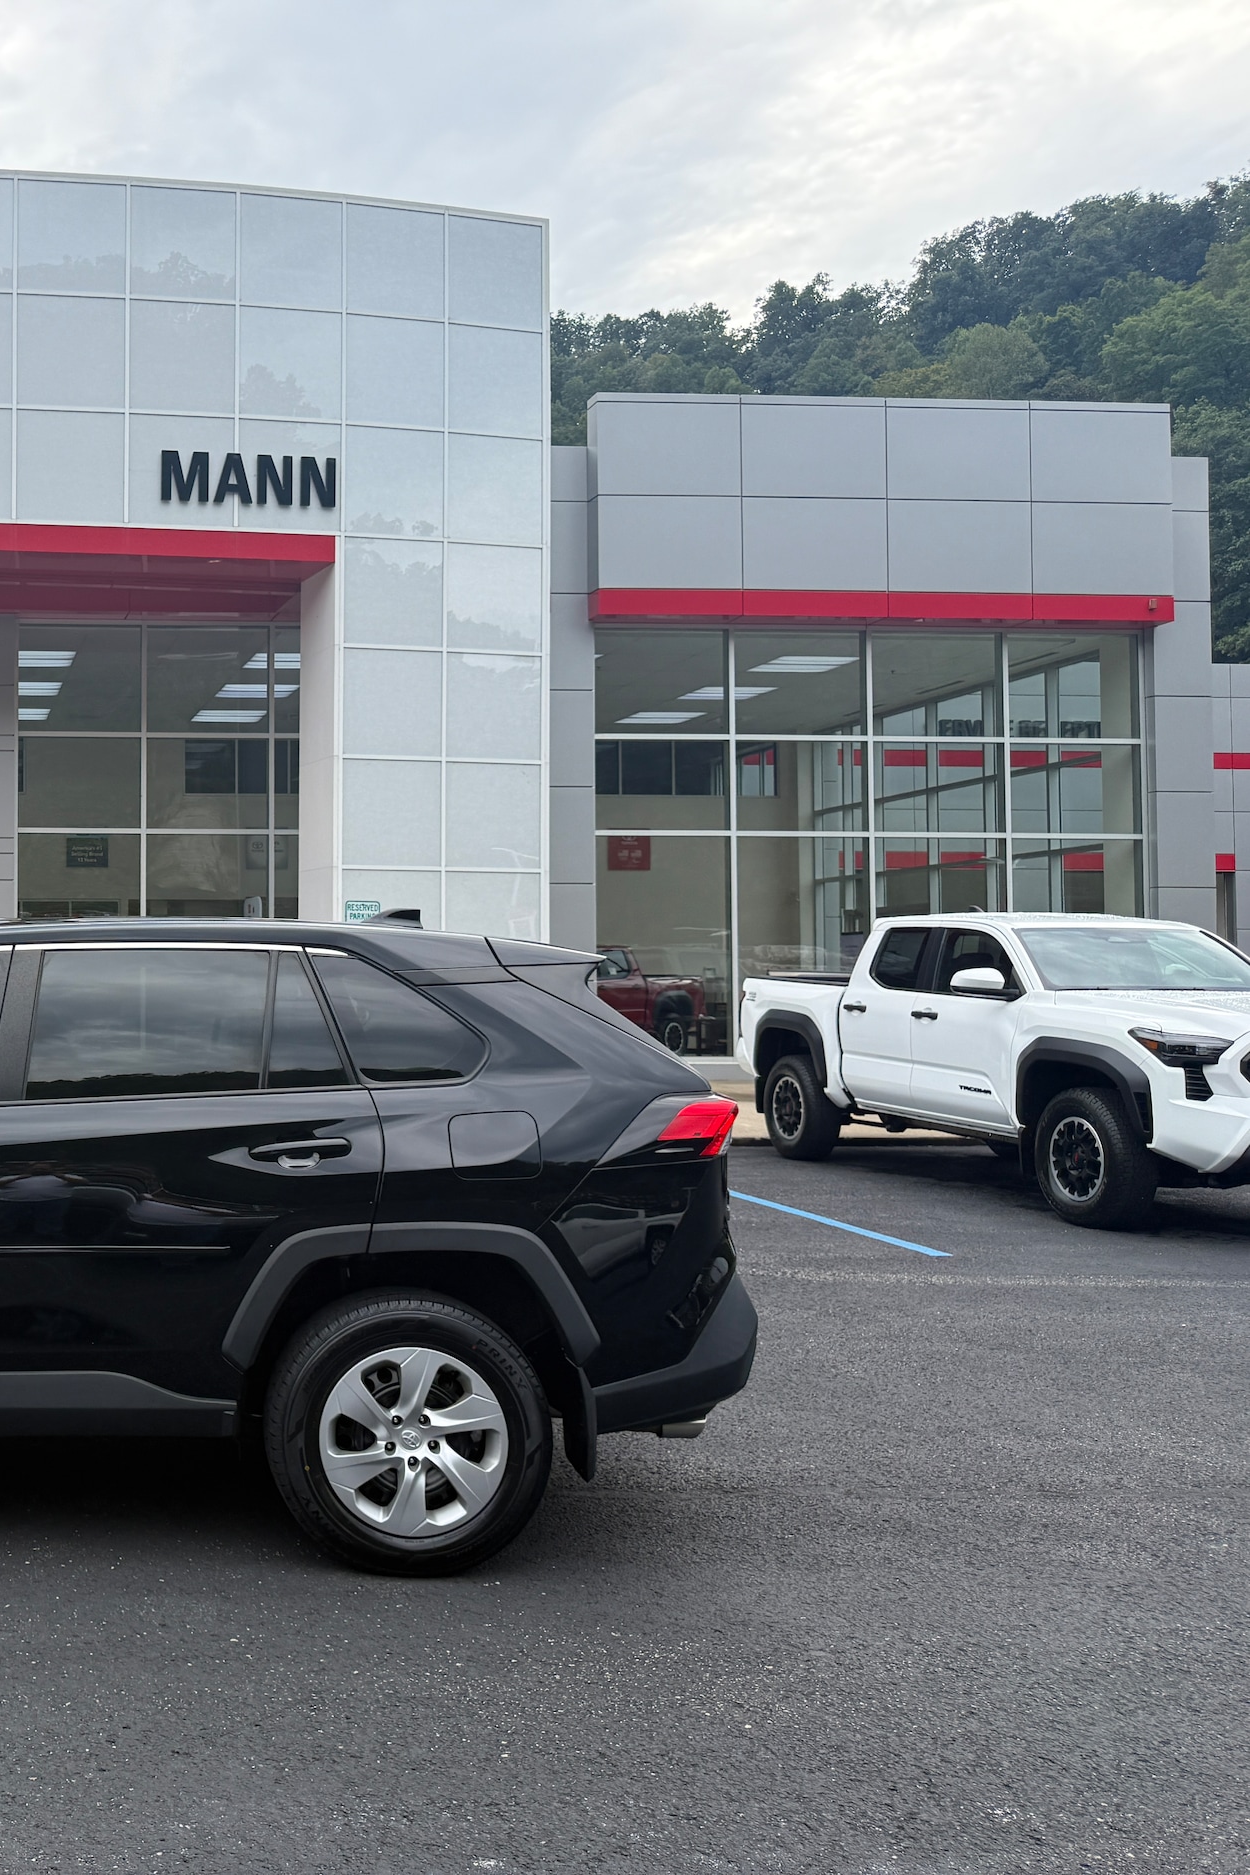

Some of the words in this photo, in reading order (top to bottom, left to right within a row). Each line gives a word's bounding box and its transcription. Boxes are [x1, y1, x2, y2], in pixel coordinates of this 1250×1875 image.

[160, 449, 337, 508] MANN
[347, 903, 379, 911] RESERVED
[350, 912, 376, 920] PARKIN
[958, 1084, 992, 1095] TACOMA
[476, 1338, 528, 1390] PRINX
